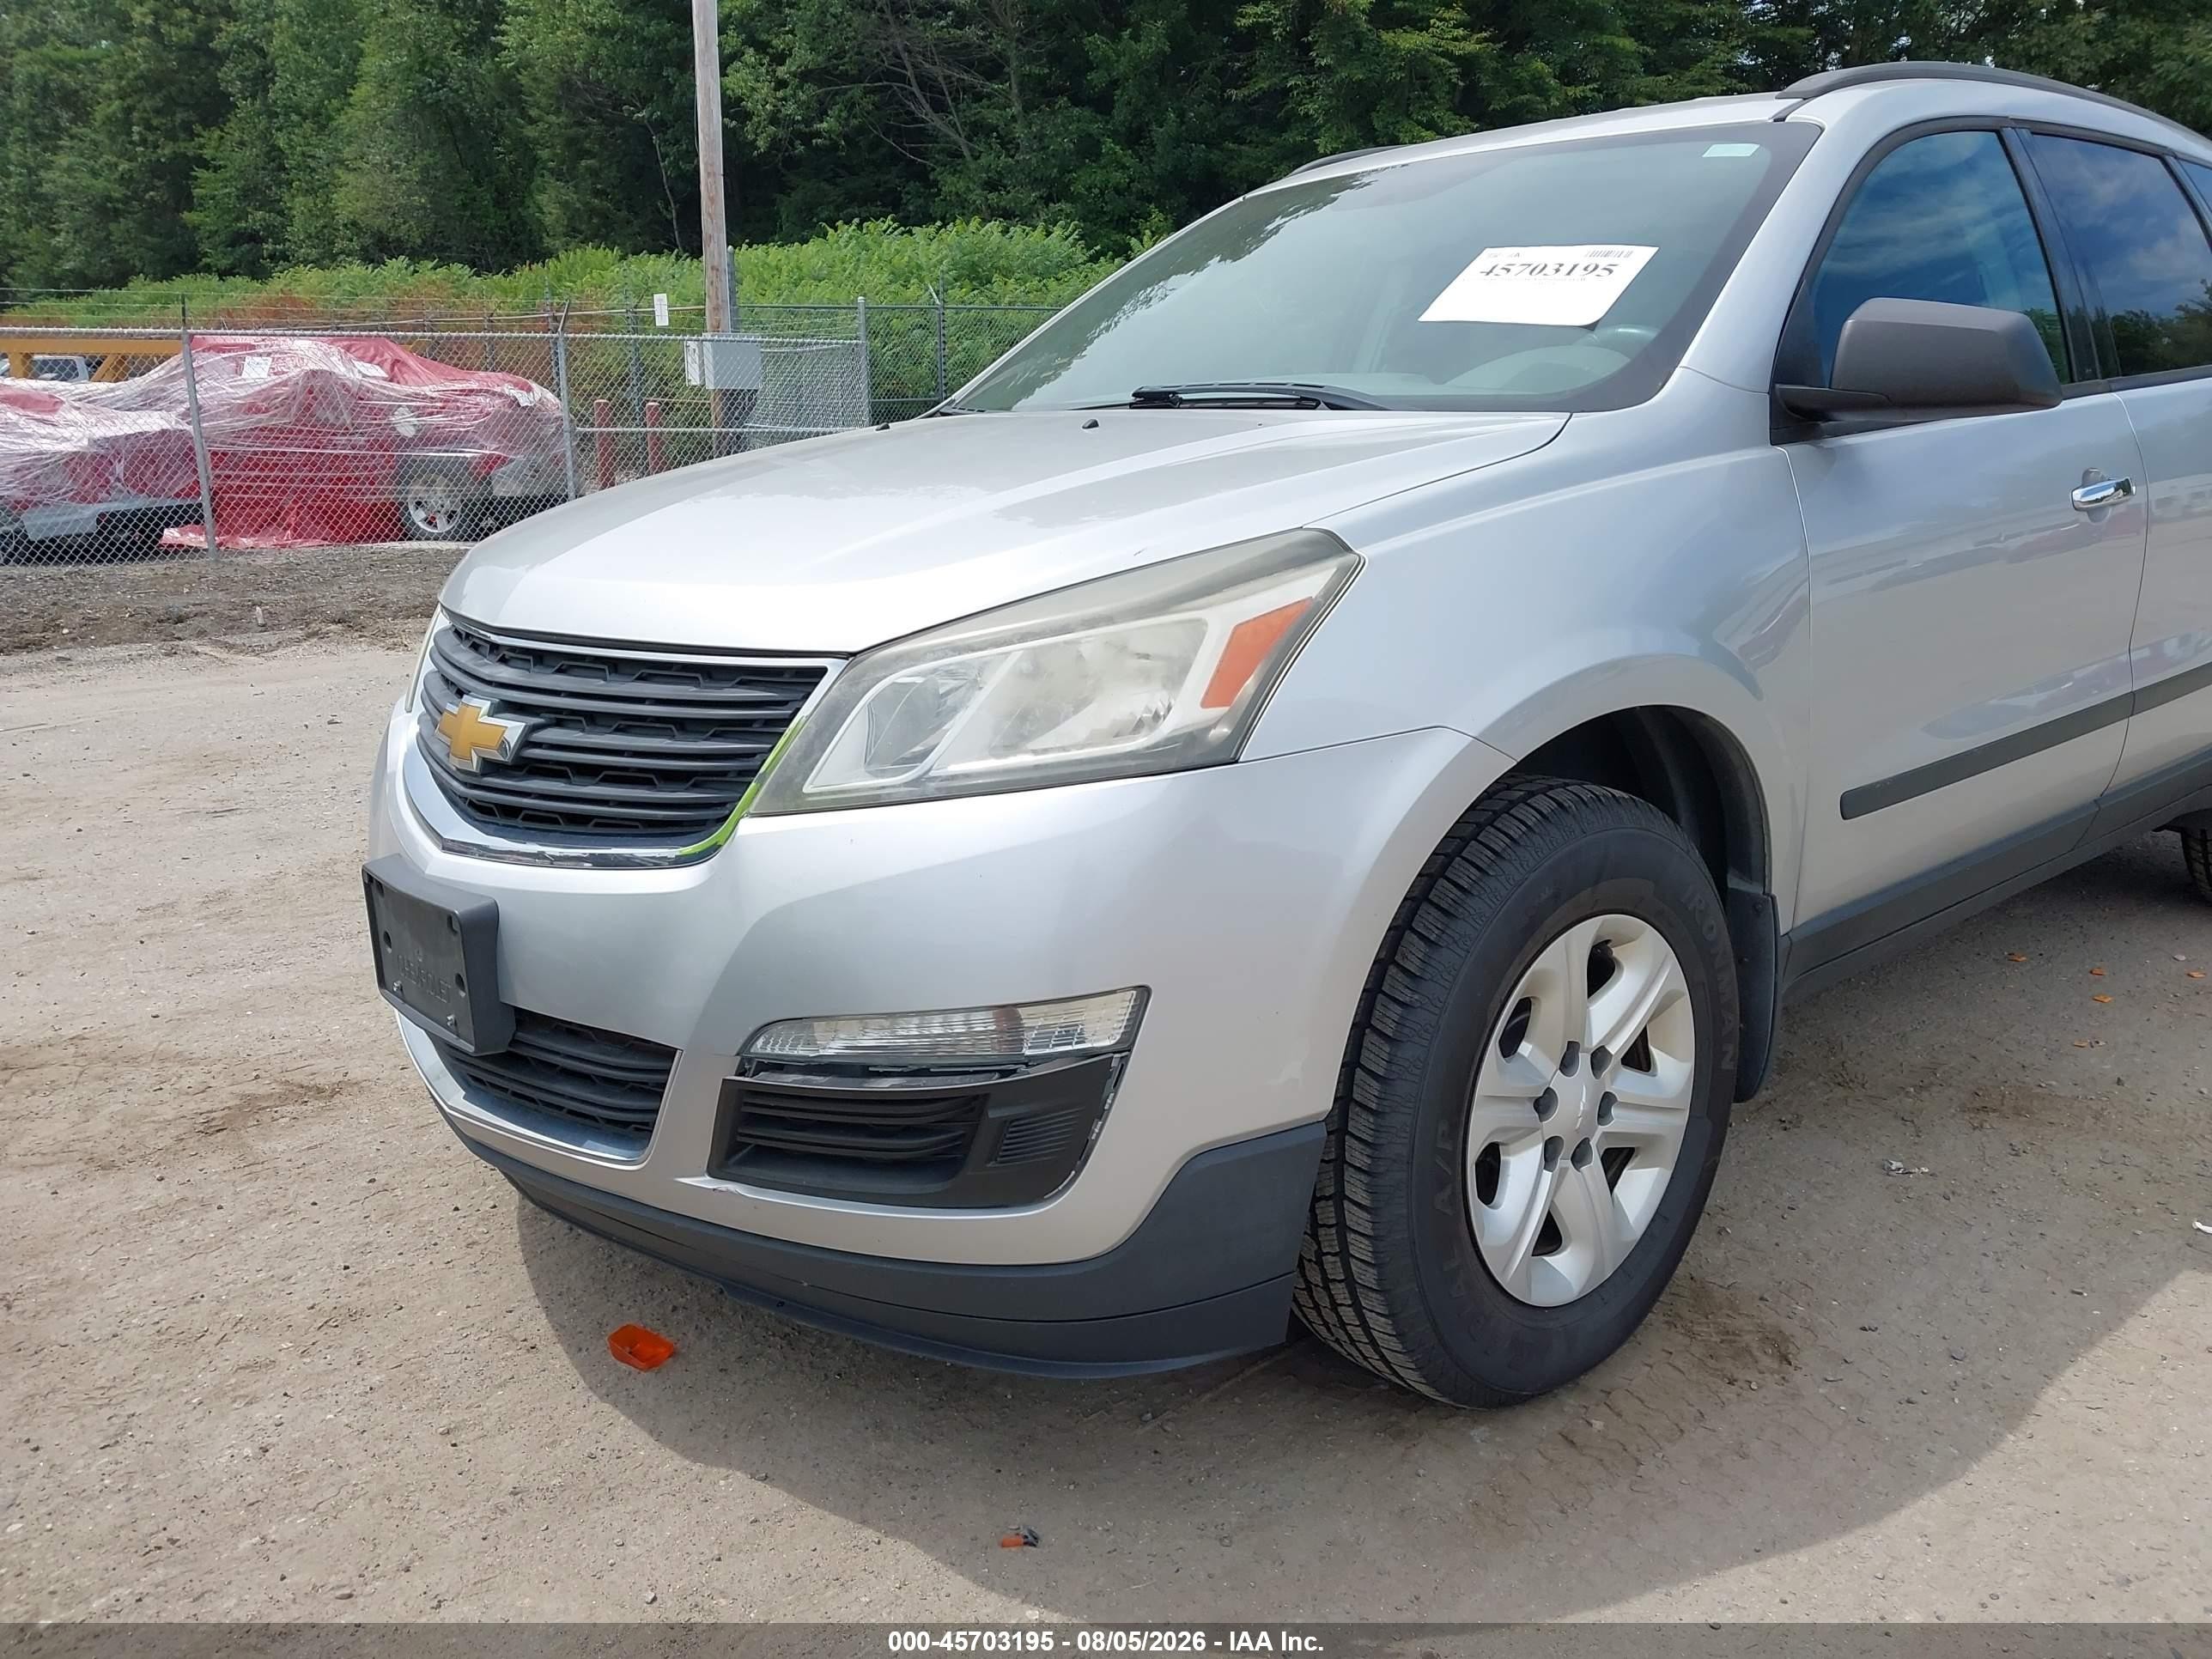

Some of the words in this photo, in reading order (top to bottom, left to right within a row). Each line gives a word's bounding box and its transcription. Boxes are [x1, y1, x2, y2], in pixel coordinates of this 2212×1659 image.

[1479, 262, 1620, 276] 45703195
[1680, 882, 1735, 1070] IRONMAN
[1434, 1119, 1457, 1216] A/P
